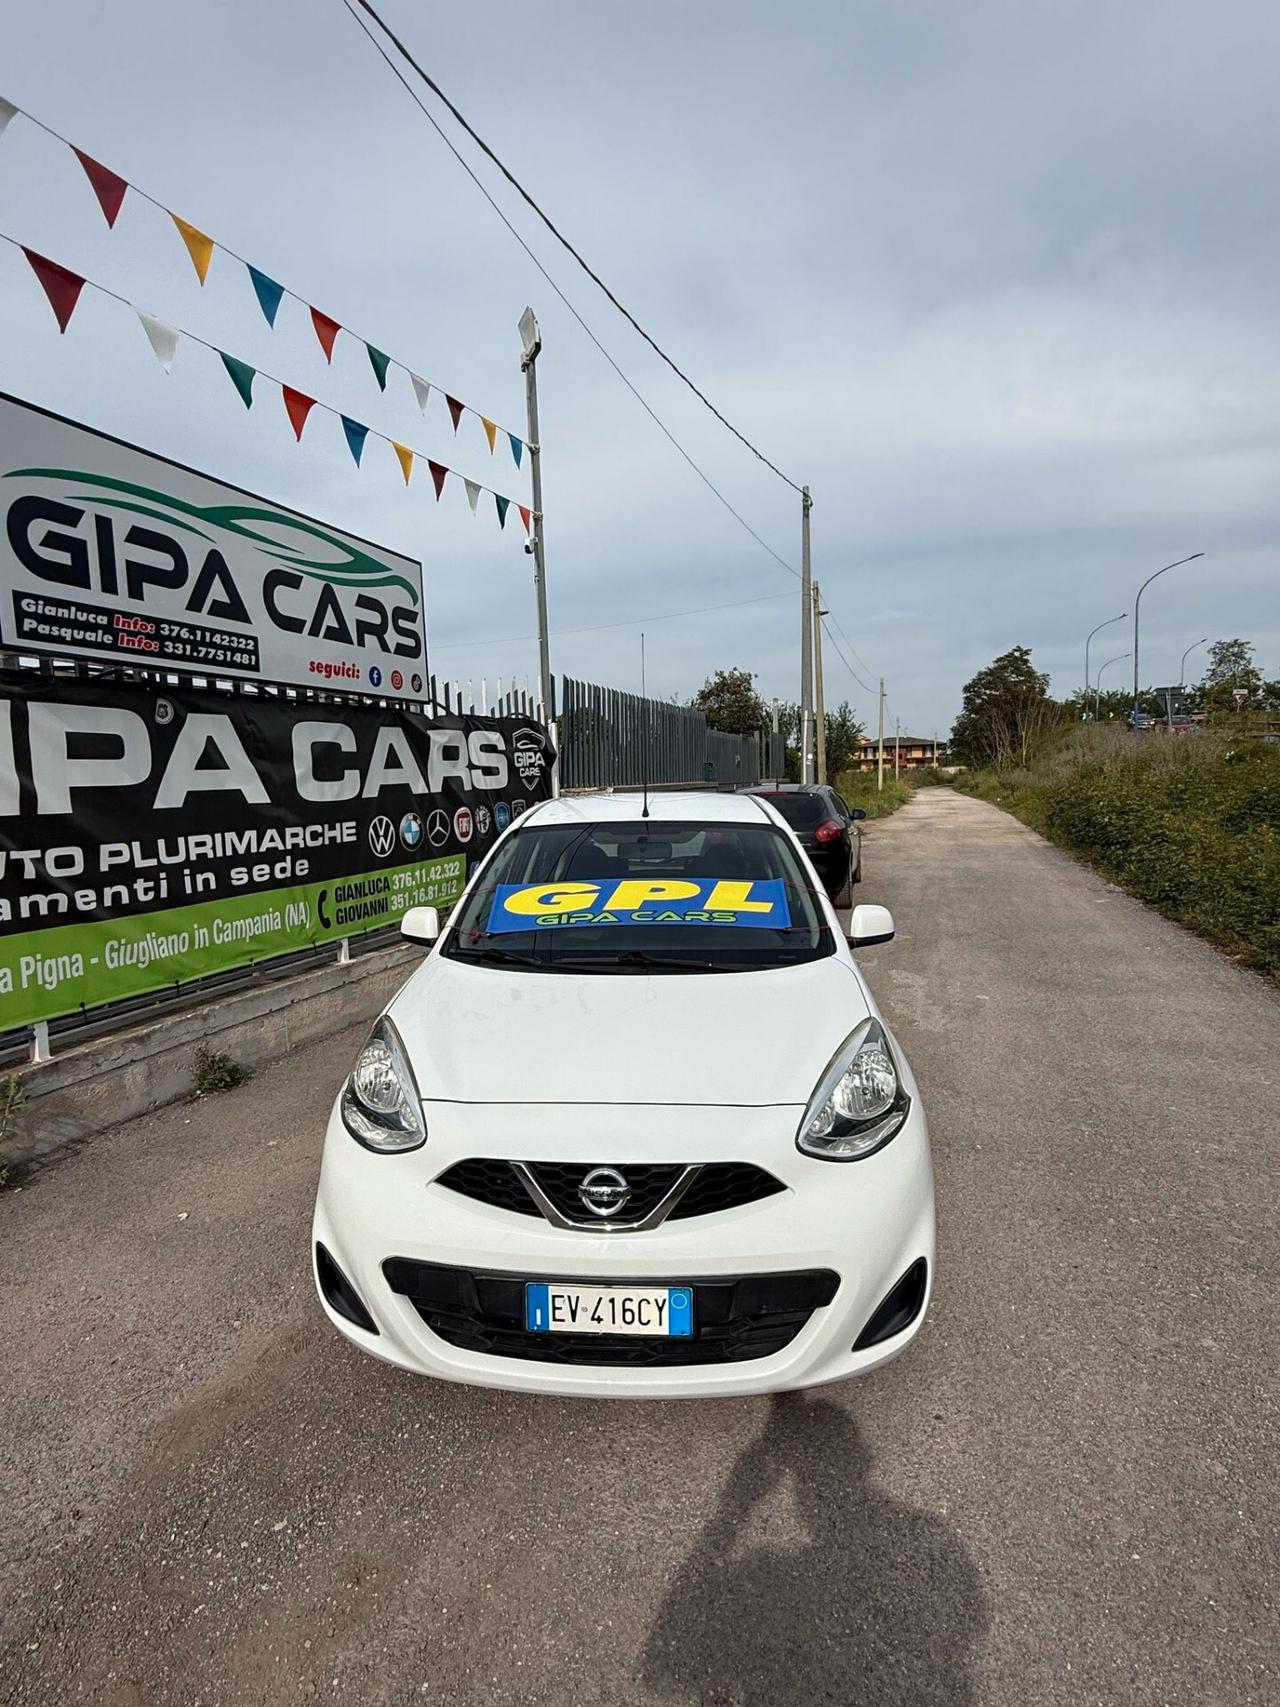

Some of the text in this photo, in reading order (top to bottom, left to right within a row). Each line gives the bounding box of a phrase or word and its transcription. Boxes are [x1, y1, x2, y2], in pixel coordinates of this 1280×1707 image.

[7, 496, 422, 659] GIPA CARS
[21, 598, 255, 650] Gianluca Info: 376.1142322
[23, 618, 256, 666] Pasquale Info: 331.7751481
[309, 661, 360, 679] seguici:
[292, 721, 509, 802] CARS
[514, 751, 546, 767] GIPA
[519, 767, 541, 777] CARS
[0, 821, 357, 880] TO PLURIMARCHE
[183, 868, 217, 895] in
[230, 856, 310, 886] sede
[335, 861, 461, 903] GIANLUCA 376.11.42.322
[336, 897, 389, 925] GIOVANNI
[503, 880, 774, 915] GPL
[535, 910, 738, 926] GIPA CARS
[20, 953, 84, 990] Pigna
[105, 931, 188, 968] Giugliano
[194, 923, 209, 950] in
[213, 907, 281, 943] Campania
[285, 902, 311, 932] (NA)
